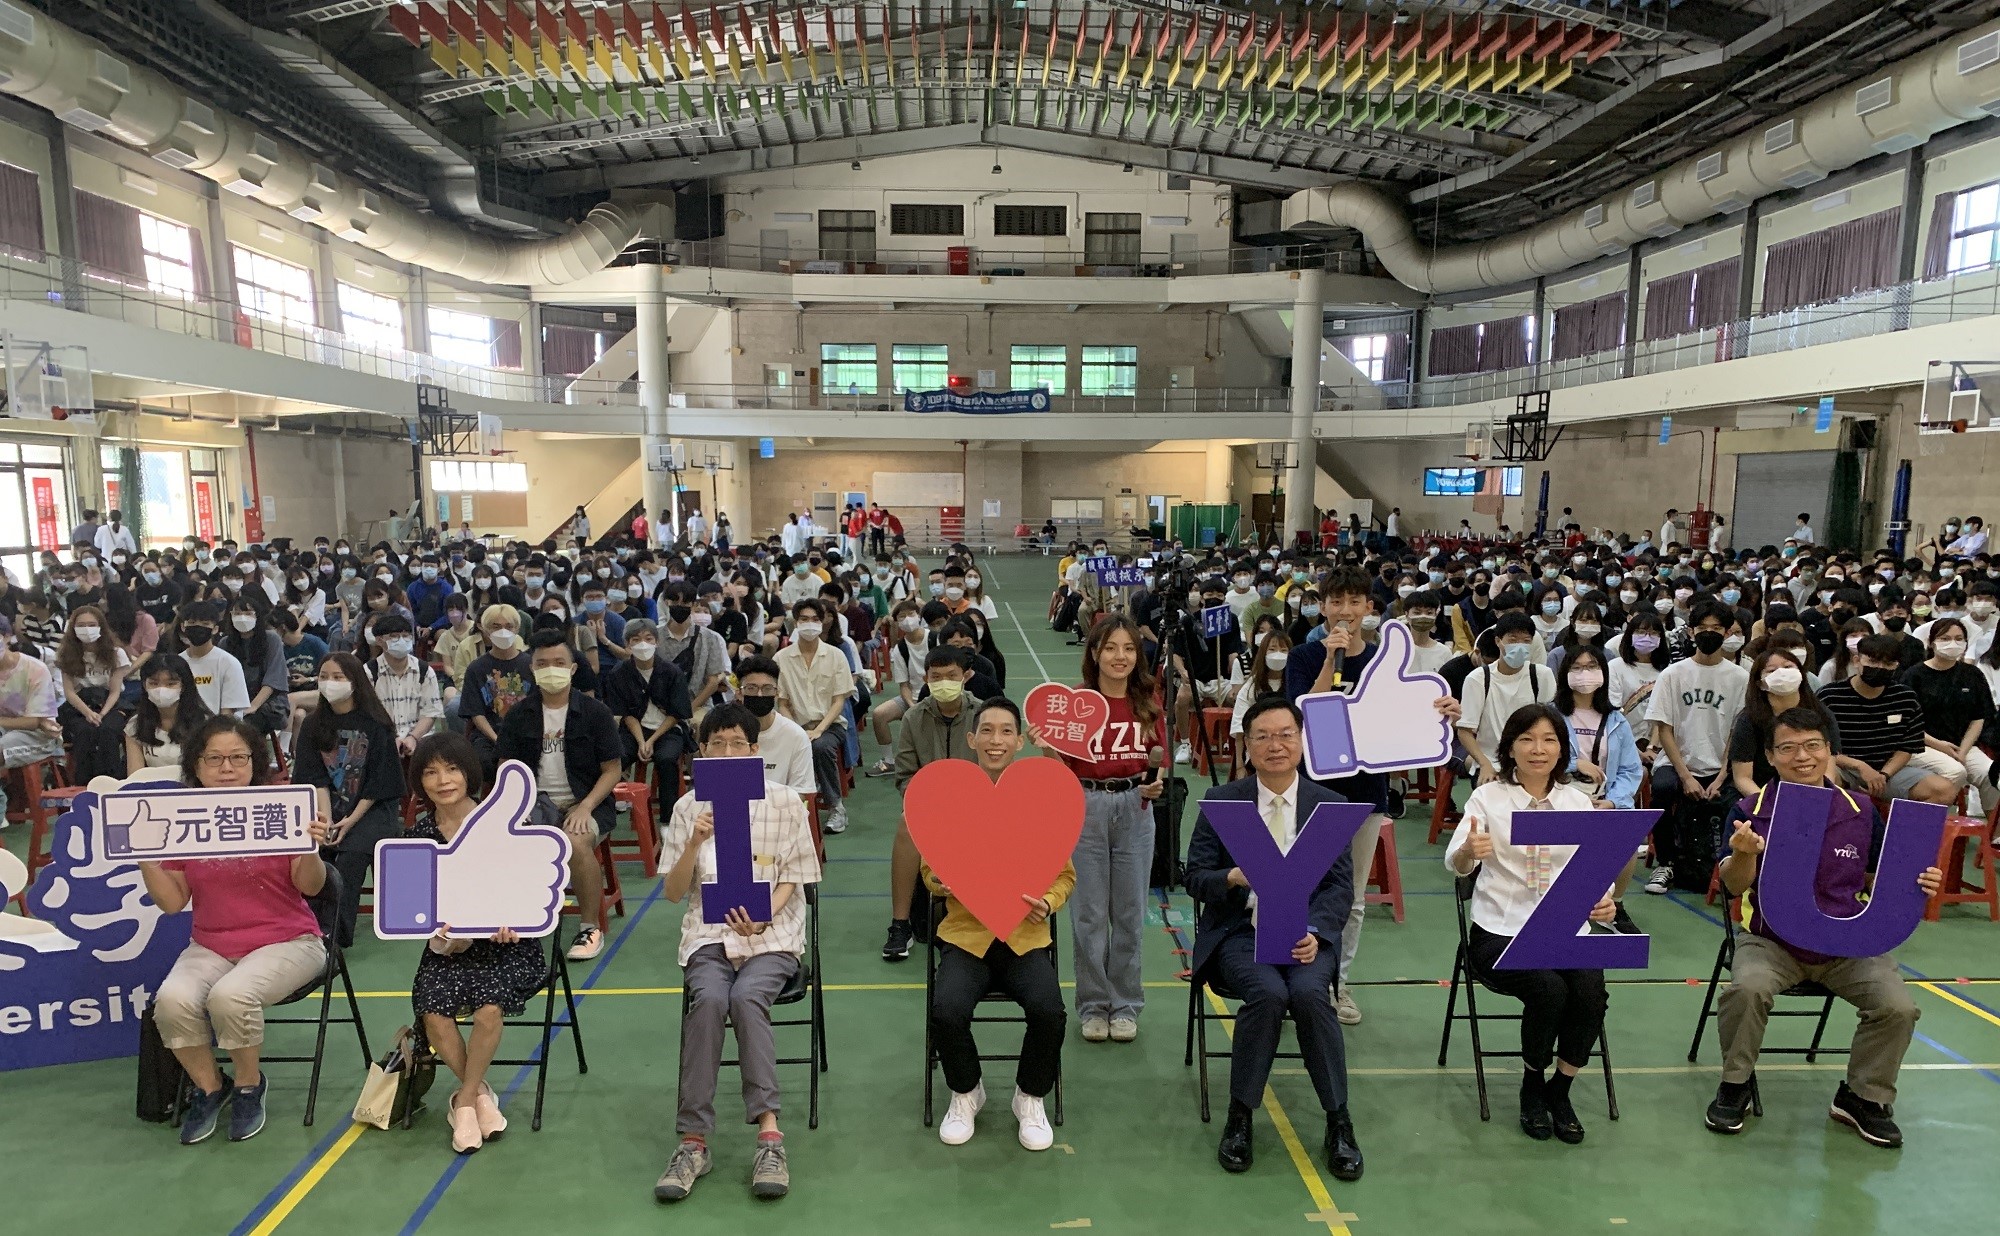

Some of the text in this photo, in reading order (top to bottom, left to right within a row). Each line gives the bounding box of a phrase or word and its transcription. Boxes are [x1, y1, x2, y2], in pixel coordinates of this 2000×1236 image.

[1043, 719, 1087, 742] 元智
[1046, 694, 1069, 715] 我
[694, 757, 772, 924] I
[1197, 800, 1376, 965] Y
[1492, 809, 1665, 970] Z
[1759, 781, 1948, 957] U
